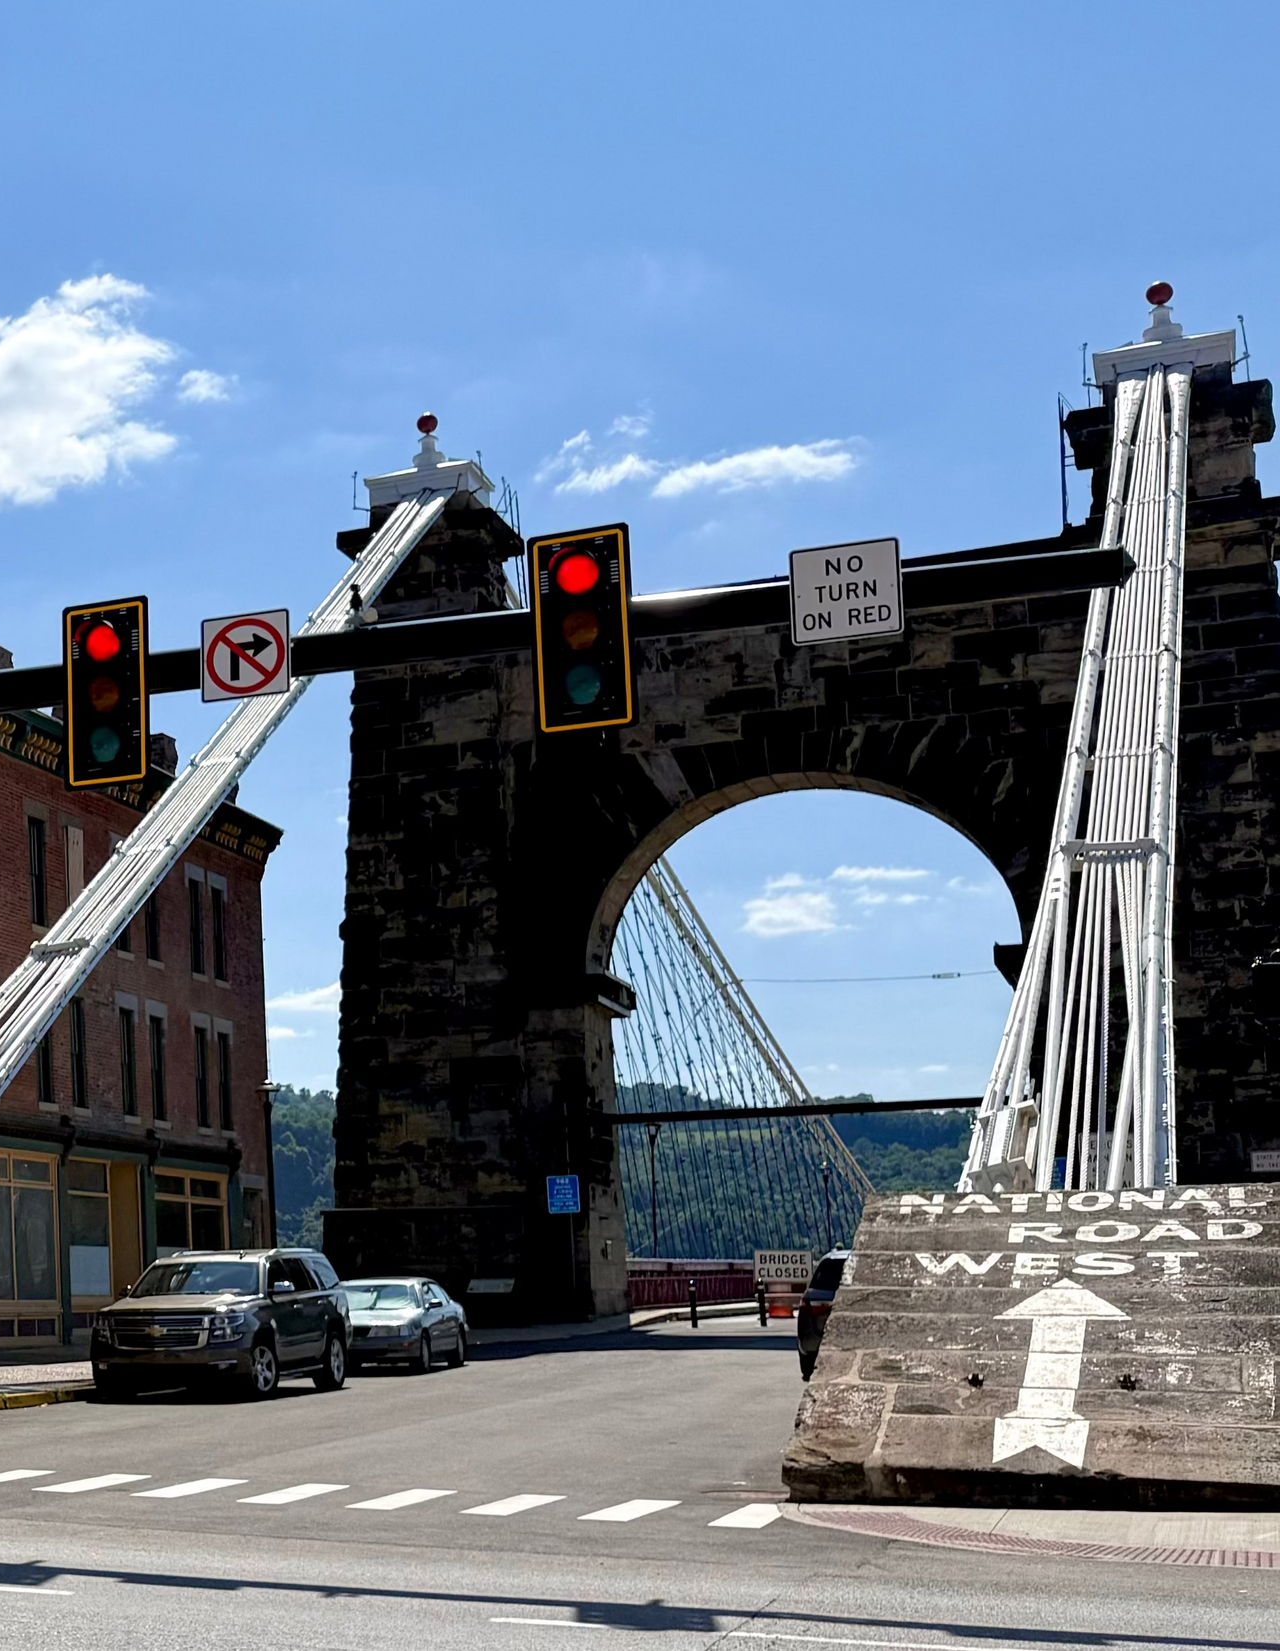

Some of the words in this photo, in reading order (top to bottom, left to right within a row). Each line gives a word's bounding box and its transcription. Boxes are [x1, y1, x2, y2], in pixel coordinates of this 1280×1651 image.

[825, 555, 863, 576] NO
[815, 579, 877, 603] TURN
[803, 611, 832, 631] ON
[848, 604, 892, 626] RED
[899, 1186, 1268, 1214] NATIONAL
[1007, 1218, 1265, 1244] ROAD
[759, 1254, 807, 1265] BRIDGE
[914, 1251, 1200, 1277] WEST
[758, 1267, 809, 1278] CLOSED
